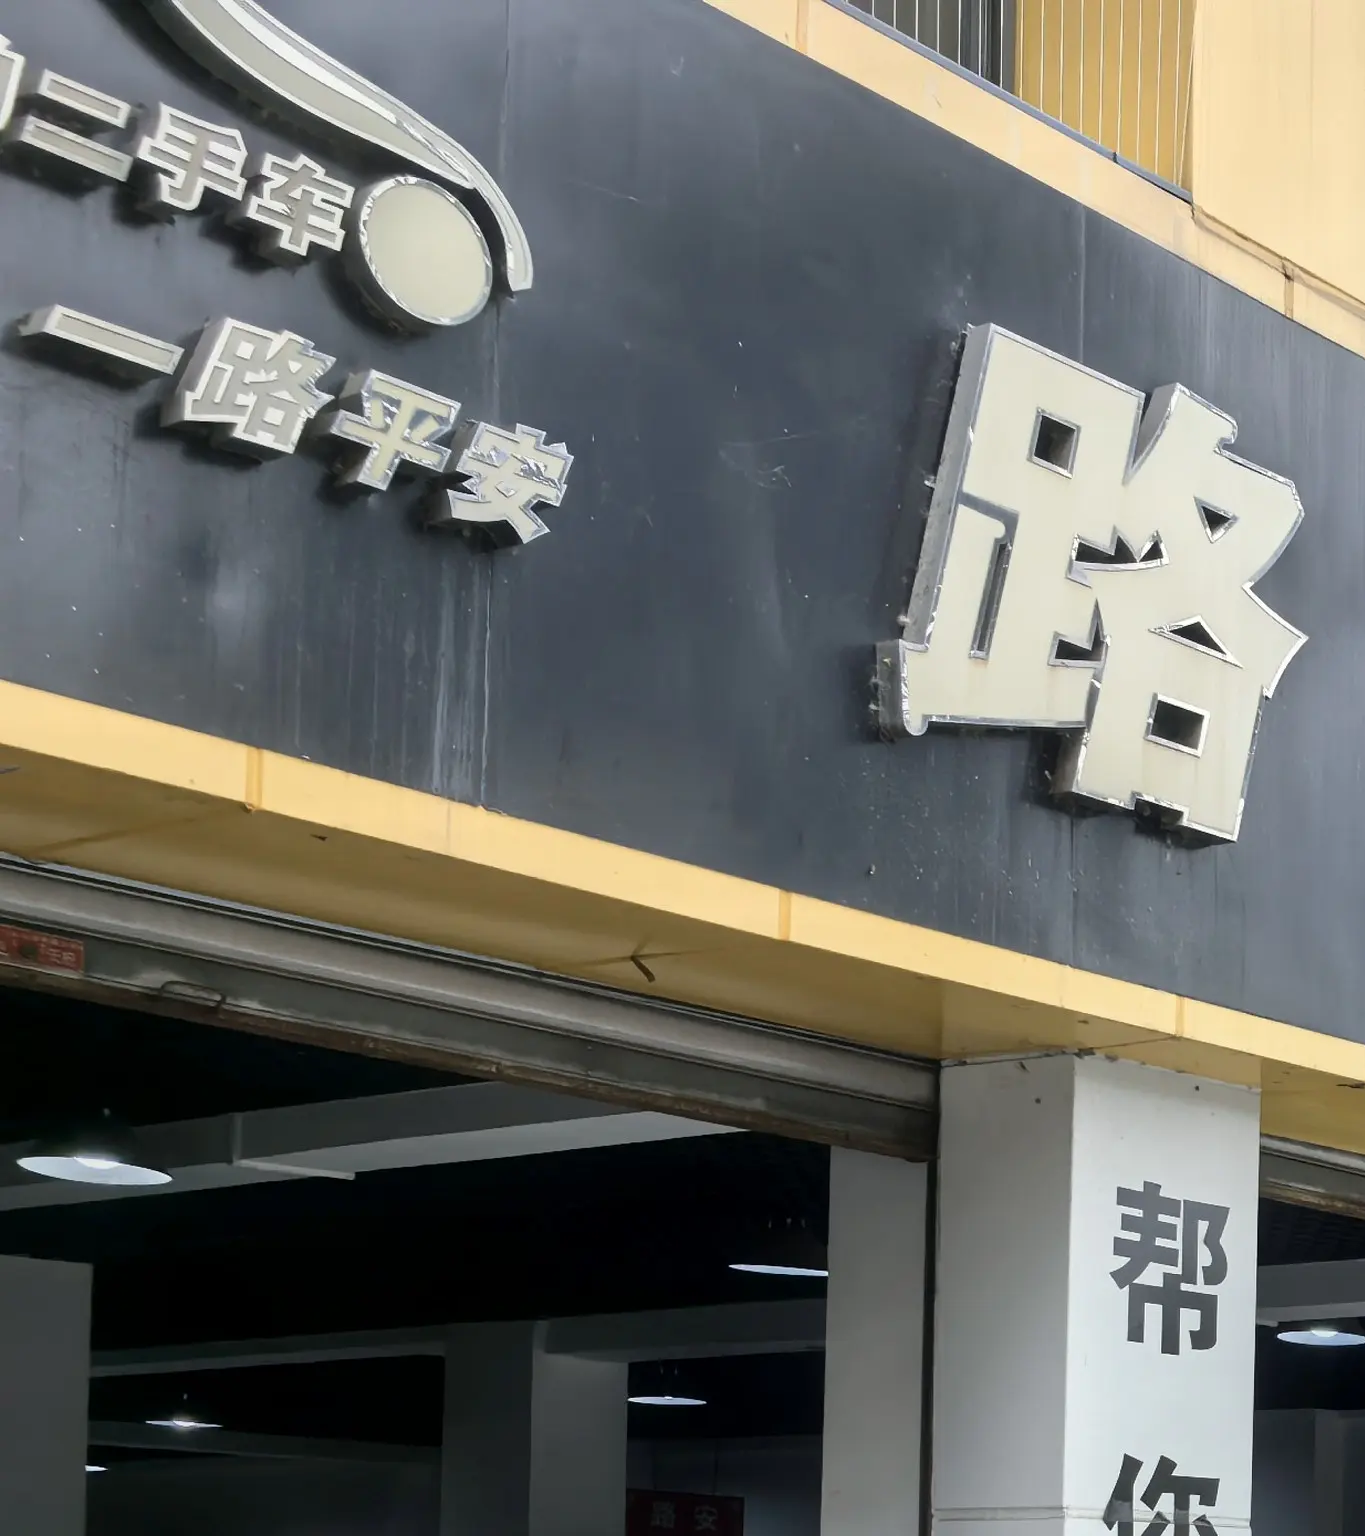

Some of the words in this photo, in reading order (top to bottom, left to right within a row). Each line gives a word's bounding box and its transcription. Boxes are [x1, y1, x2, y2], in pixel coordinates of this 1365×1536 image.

[0, 34, 355, 257] 二手车
[40, 303, 574, 543] 一路平安
[650, 1501, 718, 1531] 路安
